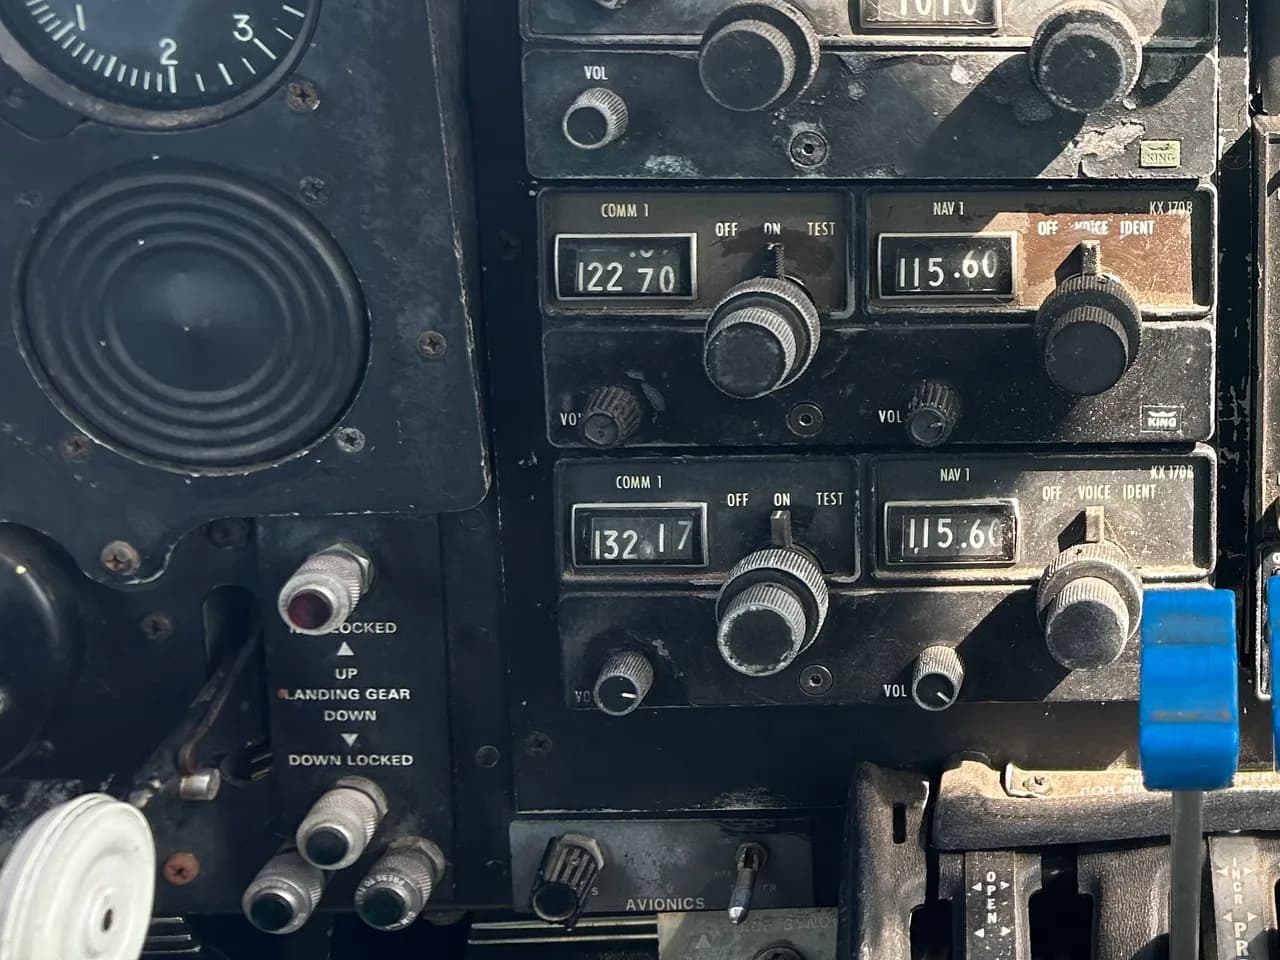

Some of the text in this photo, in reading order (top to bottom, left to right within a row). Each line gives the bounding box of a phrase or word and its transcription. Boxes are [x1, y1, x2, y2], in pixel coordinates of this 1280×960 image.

[584, 66, 608, 80] VOL
[601, 204, 637, 217] COMM
[1150, 202, 1165, 214] KX
[715, 223, 738, 237] OFF
[764, 222, 781, 236] ON
[807, 222, 835, 236] TEST
[1121, 221, 1155, 235] IDENT
[1147, 417, 1177, 427] KING
[1150, 466, 1165, 479] KX
[616, 476, 650, 489] COMM
[1043, 486, 1062, 500] OFF
[1078, 485, 1111, 499] VOICE
[1123, 485, 1157, 499] IDENT
[727, 493, 749, 507] OFF
[774, 493, 791, 506] ON
[816, 492, 844, 506] TEST
[335, 668, 359, 680] UP
[365, 689, 411, 700] GEAR
[884, 685, 906, 697] VOL
[324, 710, 377, 722] DOWN
[288, 754, 414, 766] DOWN LOCKED
[986, 871, 998, 924] OPEN
[626, 898, 704, 911] AVIONICS
